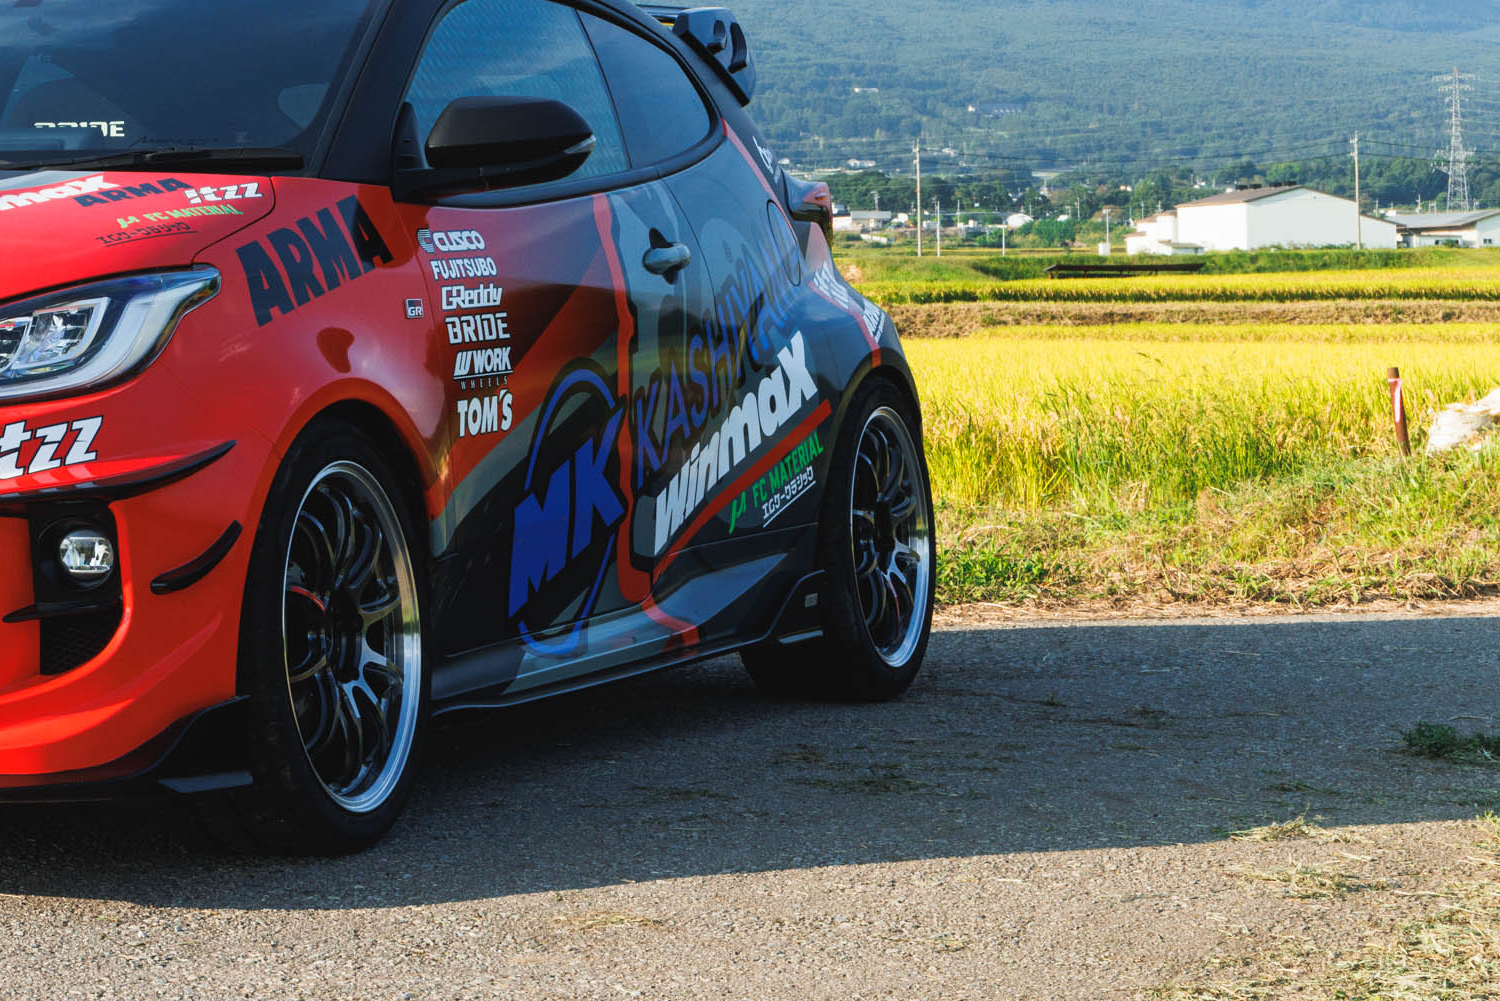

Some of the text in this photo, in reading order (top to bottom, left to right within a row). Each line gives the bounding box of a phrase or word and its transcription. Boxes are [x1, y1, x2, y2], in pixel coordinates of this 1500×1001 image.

[73, 177, 195, 208] ARMA
[143, 210, 170, 222] FC
[166, 203, 245, 219] MATERIAL
[432, 229, 486, 252] CUSCO
[236, 194, 395, 328] ARMA
[430, 256, 498, 280] FUJITSUBO
[407, 306, 423, 317] GR
[445, 312, 511, 344] BRIDE
[460, 375, 508, 390] WHEELS
[457, 389, 514, 438] TOM'S
[752, 477, 768, 508] FC
[769, 431, 824, 495] MATERIAL
[509, 404, 625, 618] MK
